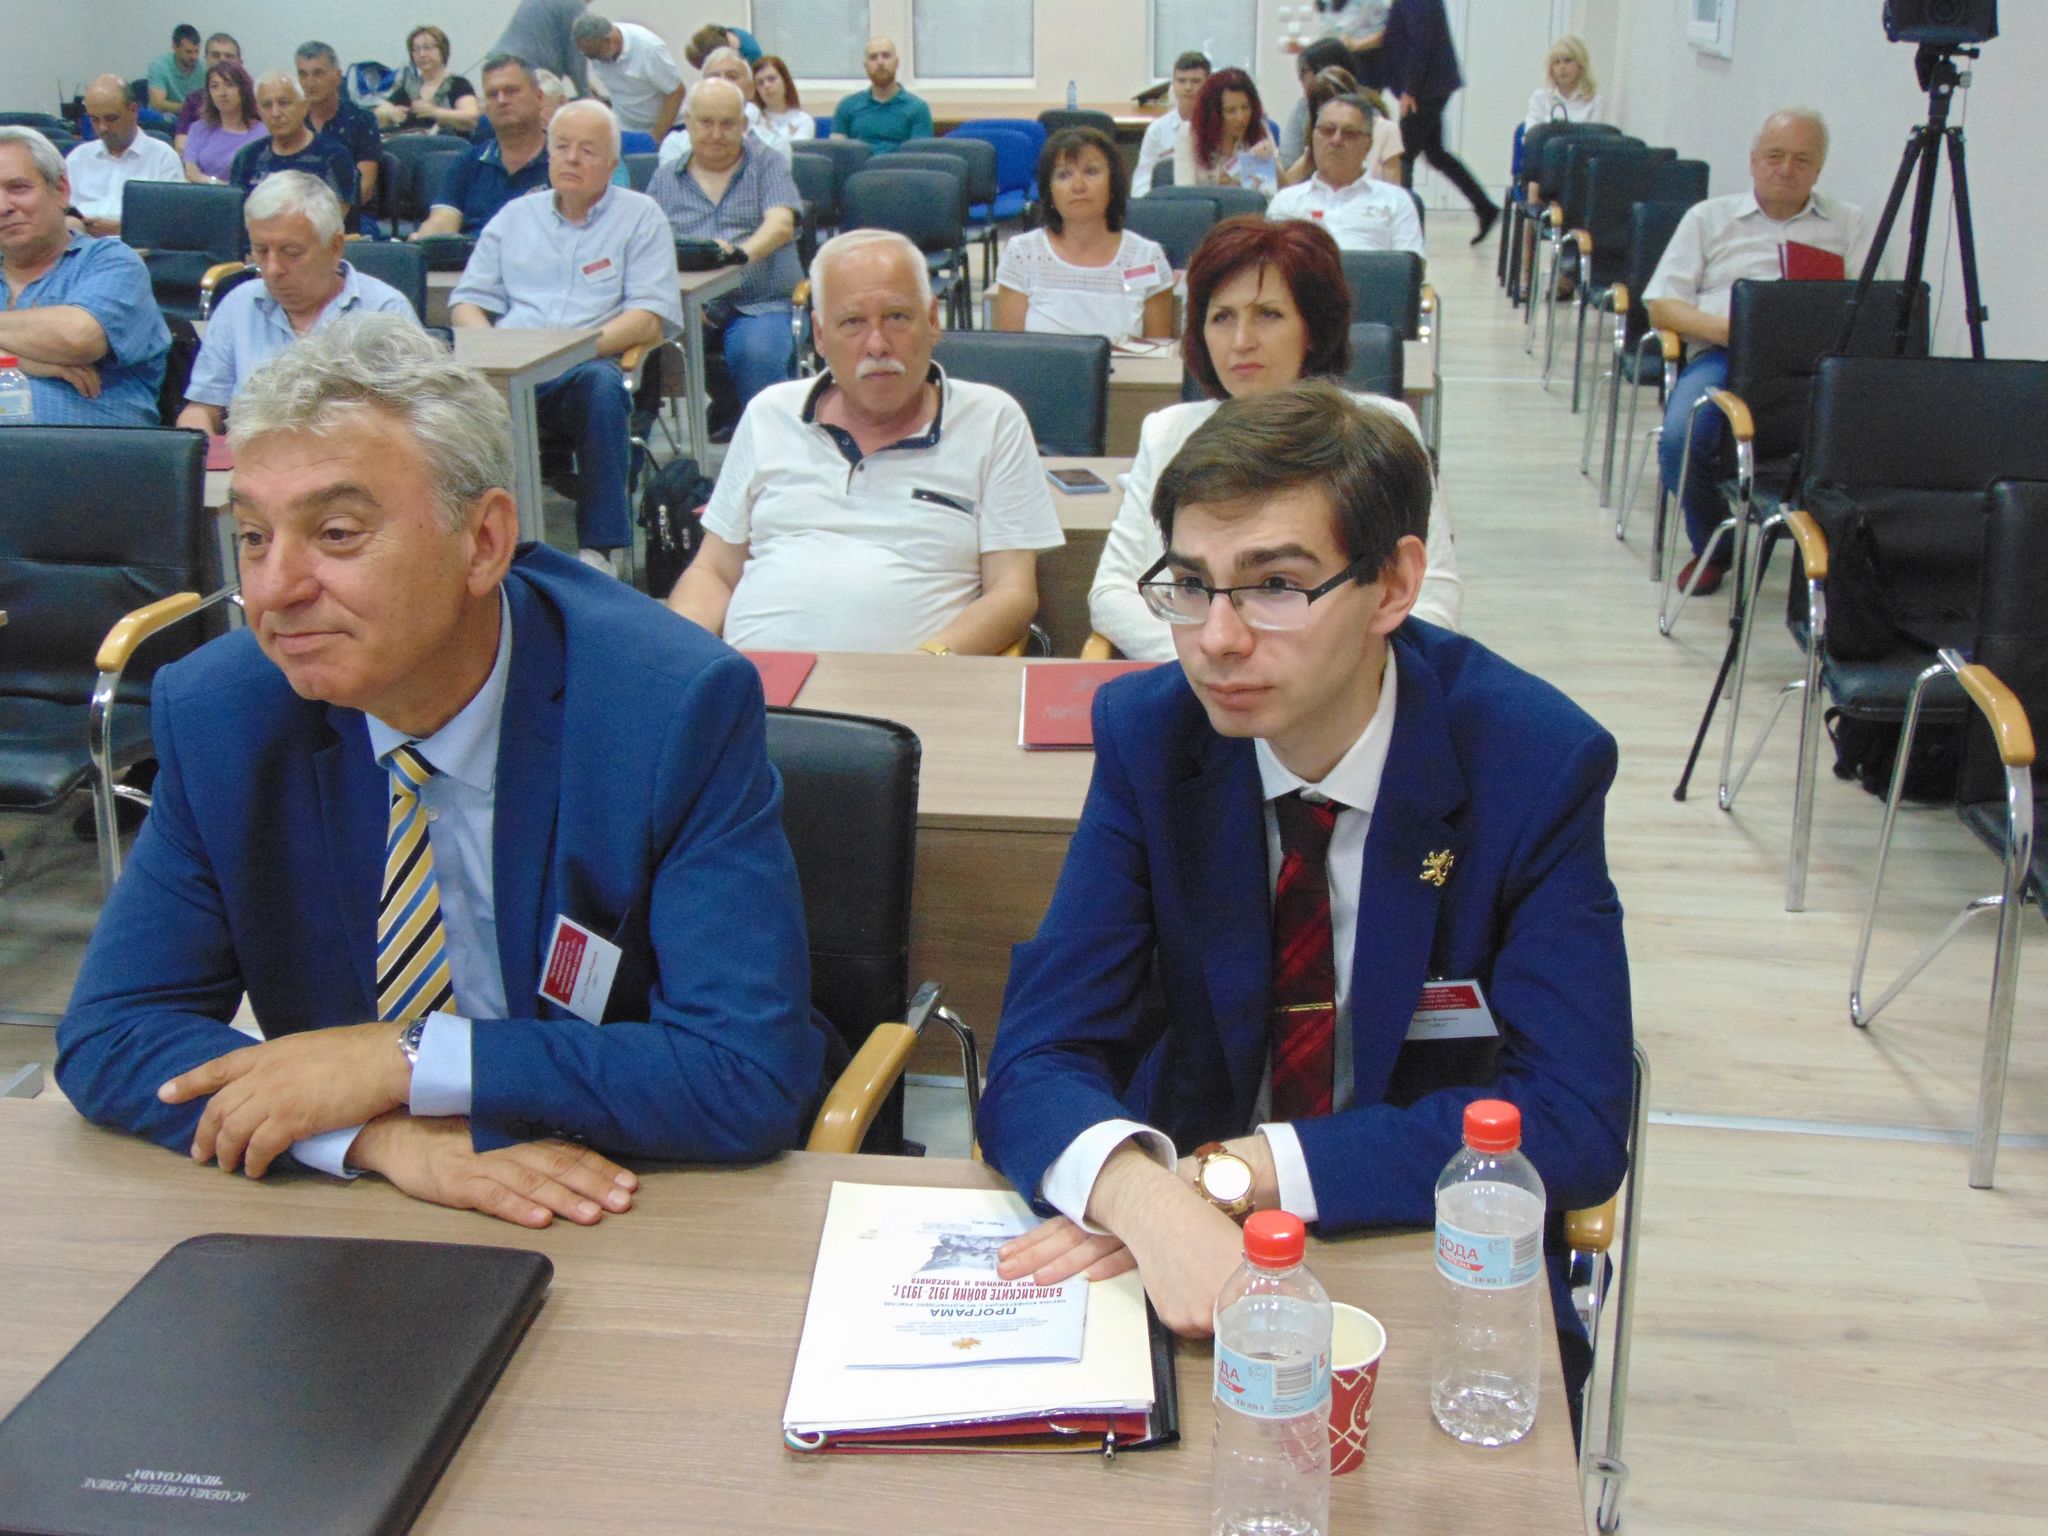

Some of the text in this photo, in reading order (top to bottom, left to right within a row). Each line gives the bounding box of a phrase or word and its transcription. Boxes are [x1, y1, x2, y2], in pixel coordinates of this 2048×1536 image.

[1439, 1233, 1479, 1261] ВОДА
[953, 1287, 987, 1301] ВОЙНИ
[990, 1287, 1063, 1300] БАЛКАНСКИТЕ
[930, 1308, 1016, 1317] ПРОГРАМА
[190, 1487, 250, 1502] ACADEMIA
